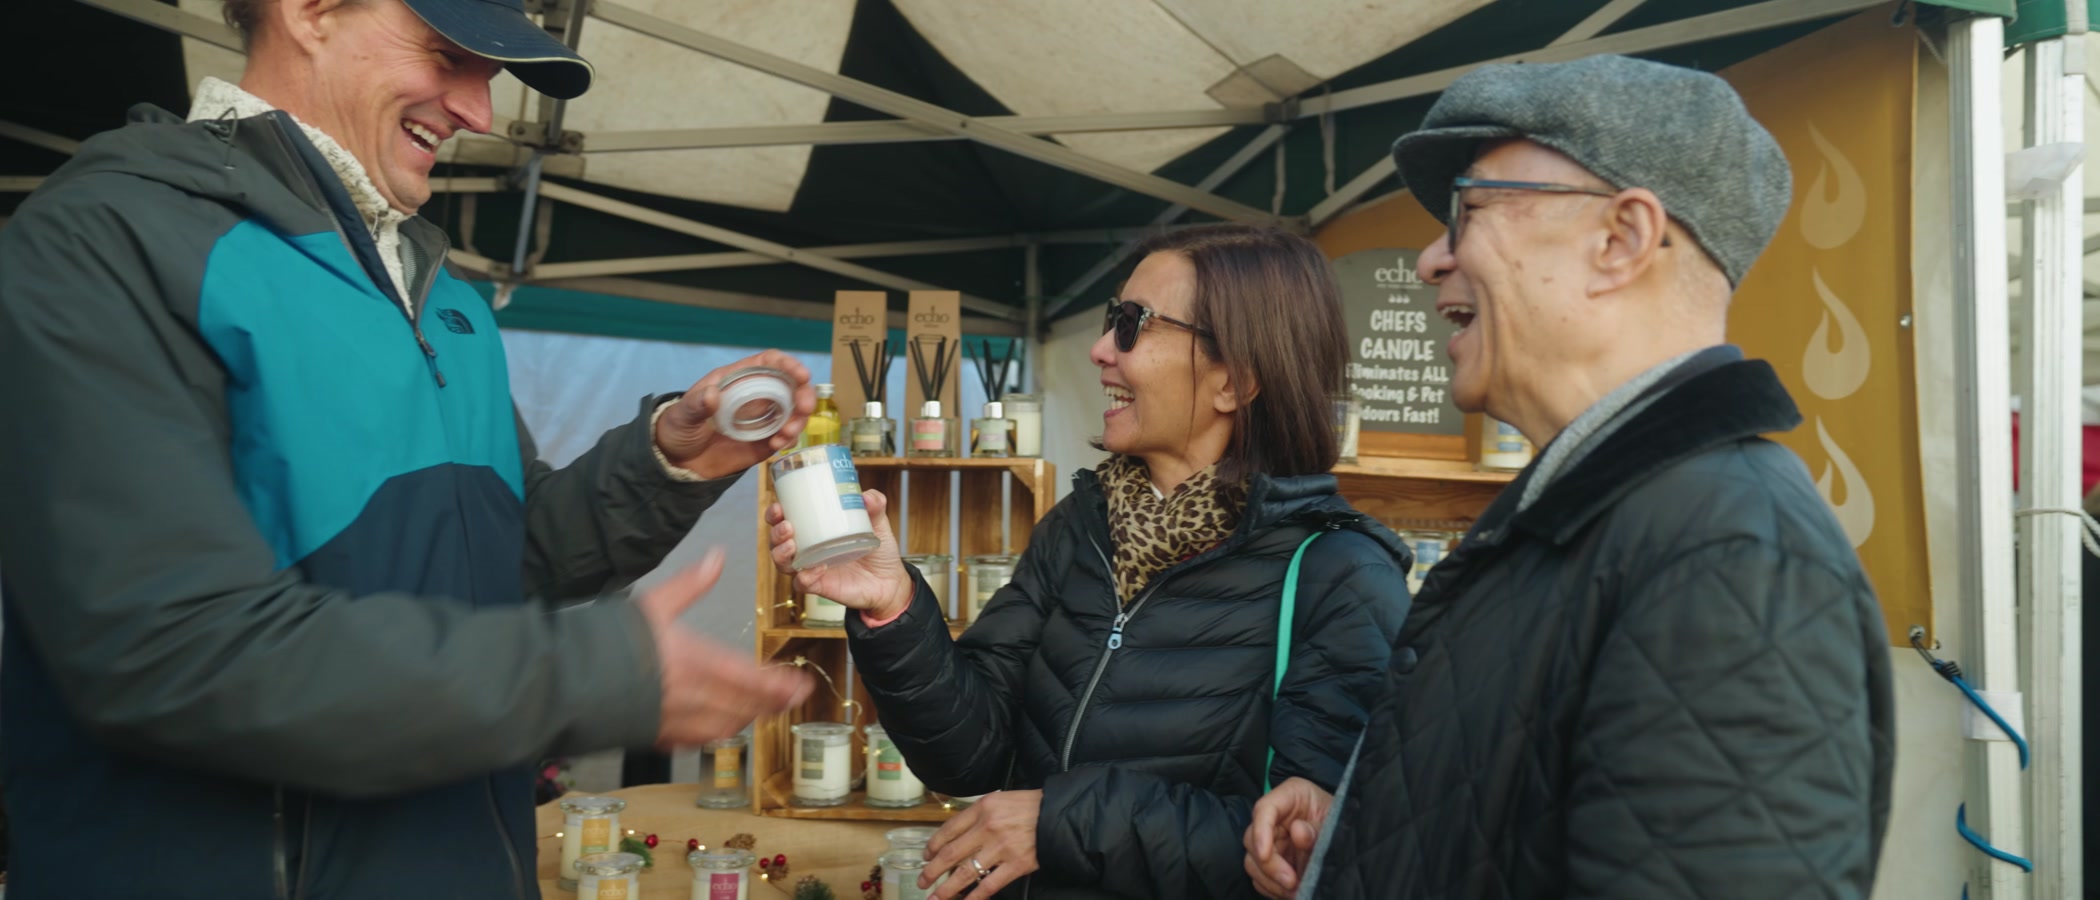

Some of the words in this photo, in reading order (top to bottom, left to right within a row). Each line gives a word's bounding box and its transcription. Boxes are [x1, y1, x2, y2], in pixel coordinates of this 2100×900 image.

[839, 306, 875, 325] echo
[914, 304, 950, 324] echo
[1369, 309, 1428, 333] CHEFS
[1360, 337, 1436, 362] CANDLE
[1422, 365, 1450, 383] ALL
[1406, 386, 1419, 403] &
[1421, 386, 1445, 404] Pet
[1360, 405, 1401, 423] dours
[1403, 406, 1441, 425] Fast!
[832, 452, 854, 469] ech
[711, 876, 738, 891] echo
